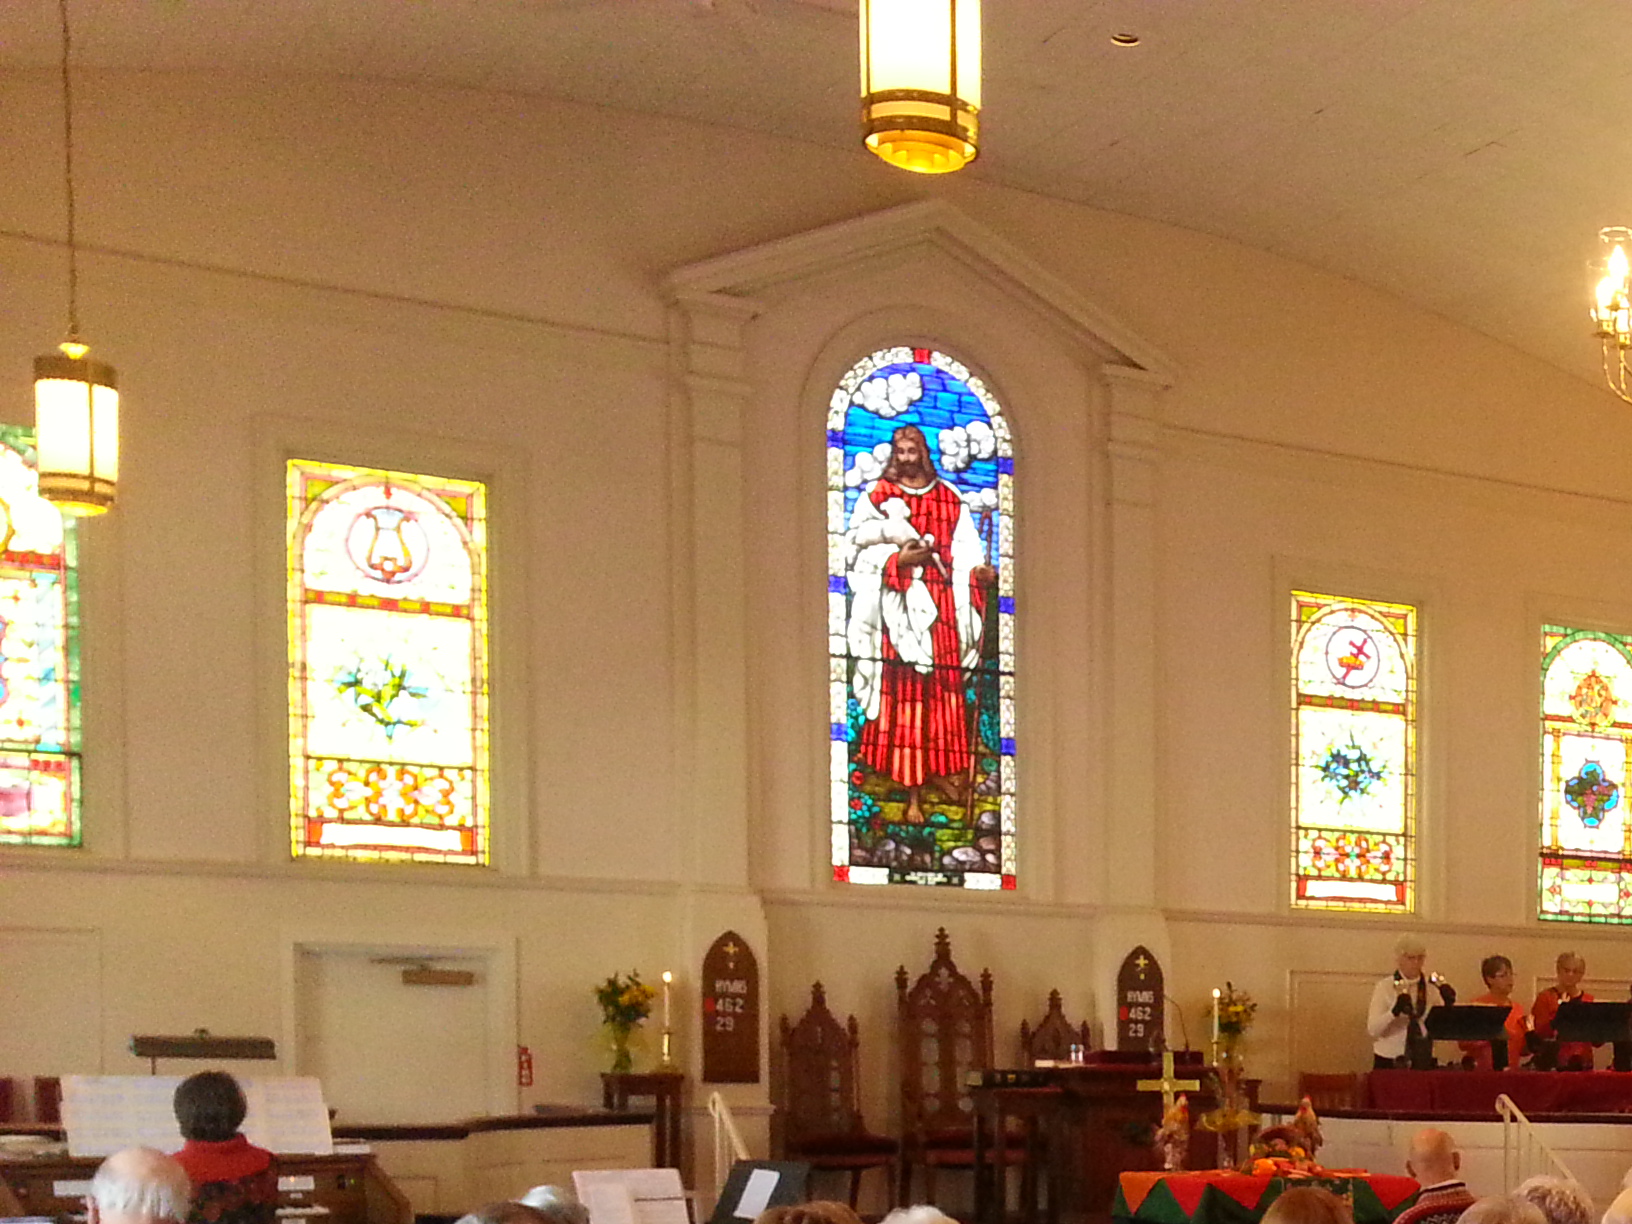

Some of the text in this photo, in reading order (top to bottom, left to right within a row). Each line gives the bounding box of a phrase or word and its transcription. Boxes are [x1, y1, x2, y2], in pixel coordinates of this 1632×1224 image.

[716, 997, 744, 1013] 462
[1129, 1006, 1151, 1020] 462
[715, 1016, 734, 1031] 29
[1129, 1023, 1144, 1037] 29
